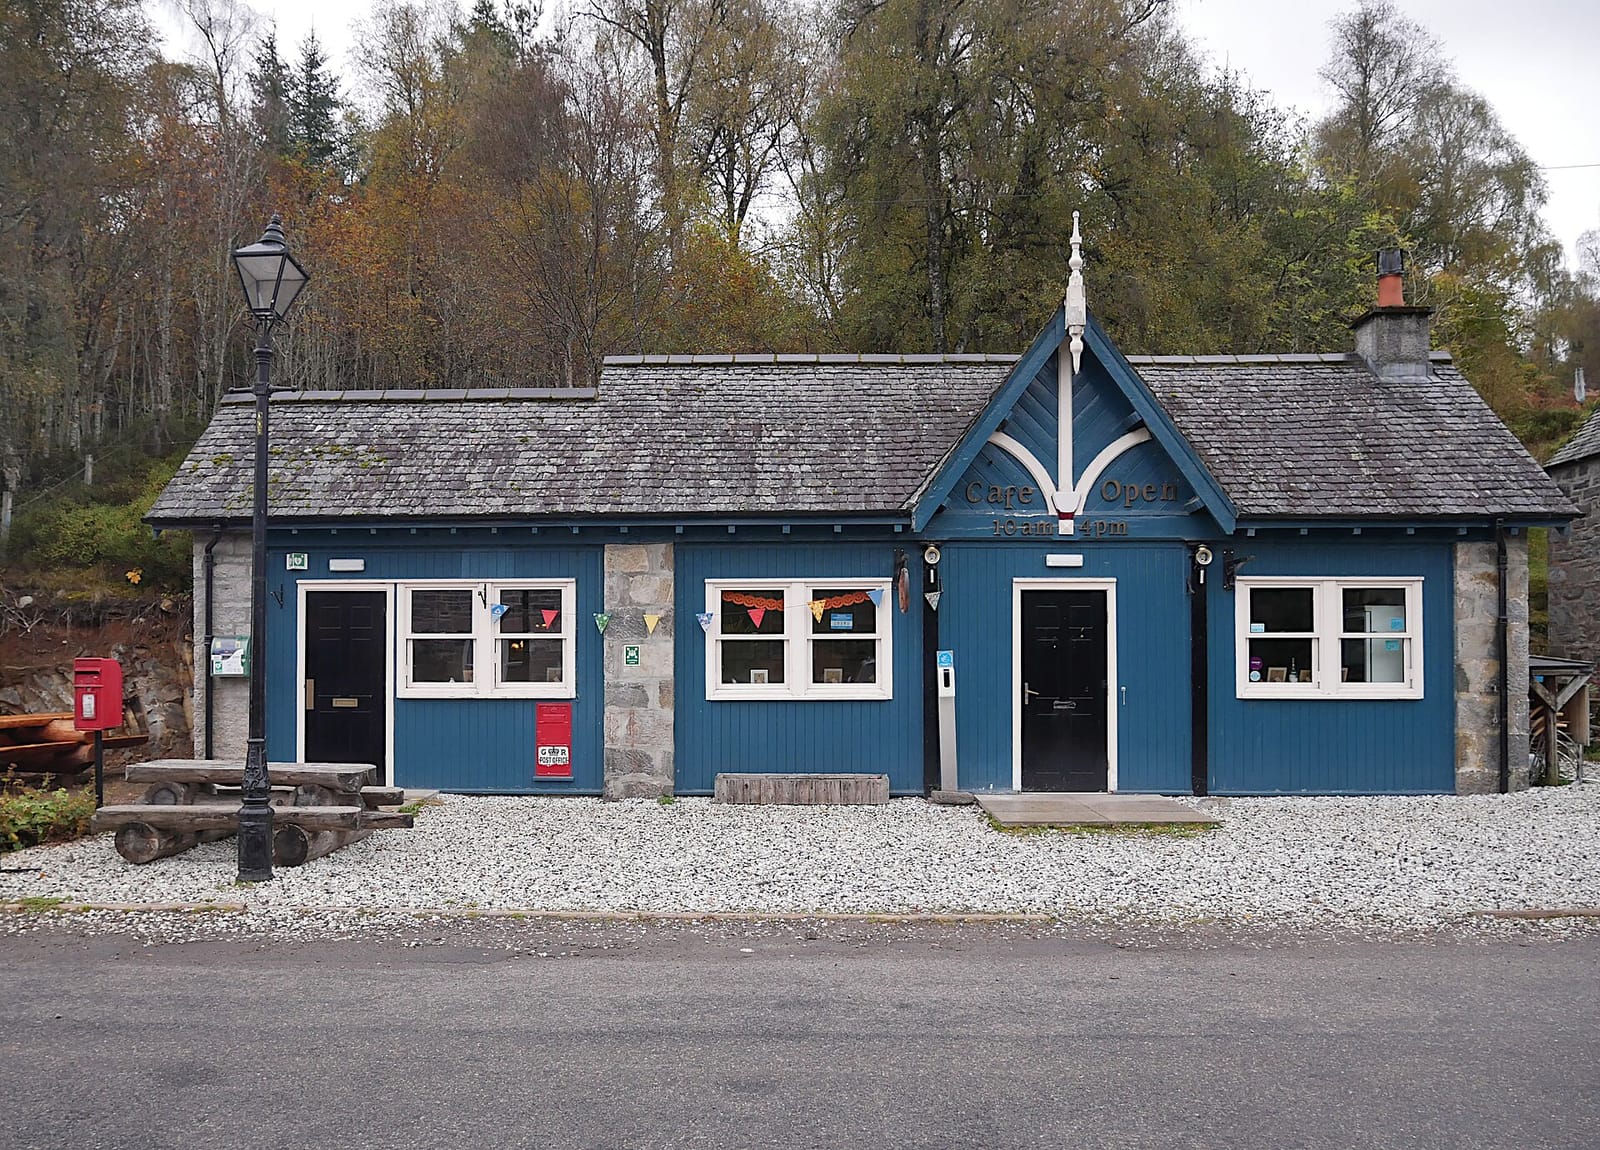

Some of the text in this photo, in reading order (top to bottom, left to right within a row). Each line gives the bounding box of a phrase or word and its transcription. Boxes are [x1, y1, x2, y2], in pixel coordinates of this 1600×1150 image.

[966, 479, 1177, 509] Cafe Open
[993, 519, 1128, 538] 10am 4pm
[541, 748, 567, 756] G R
[540, 756, 568, 764] POST OFFICE
